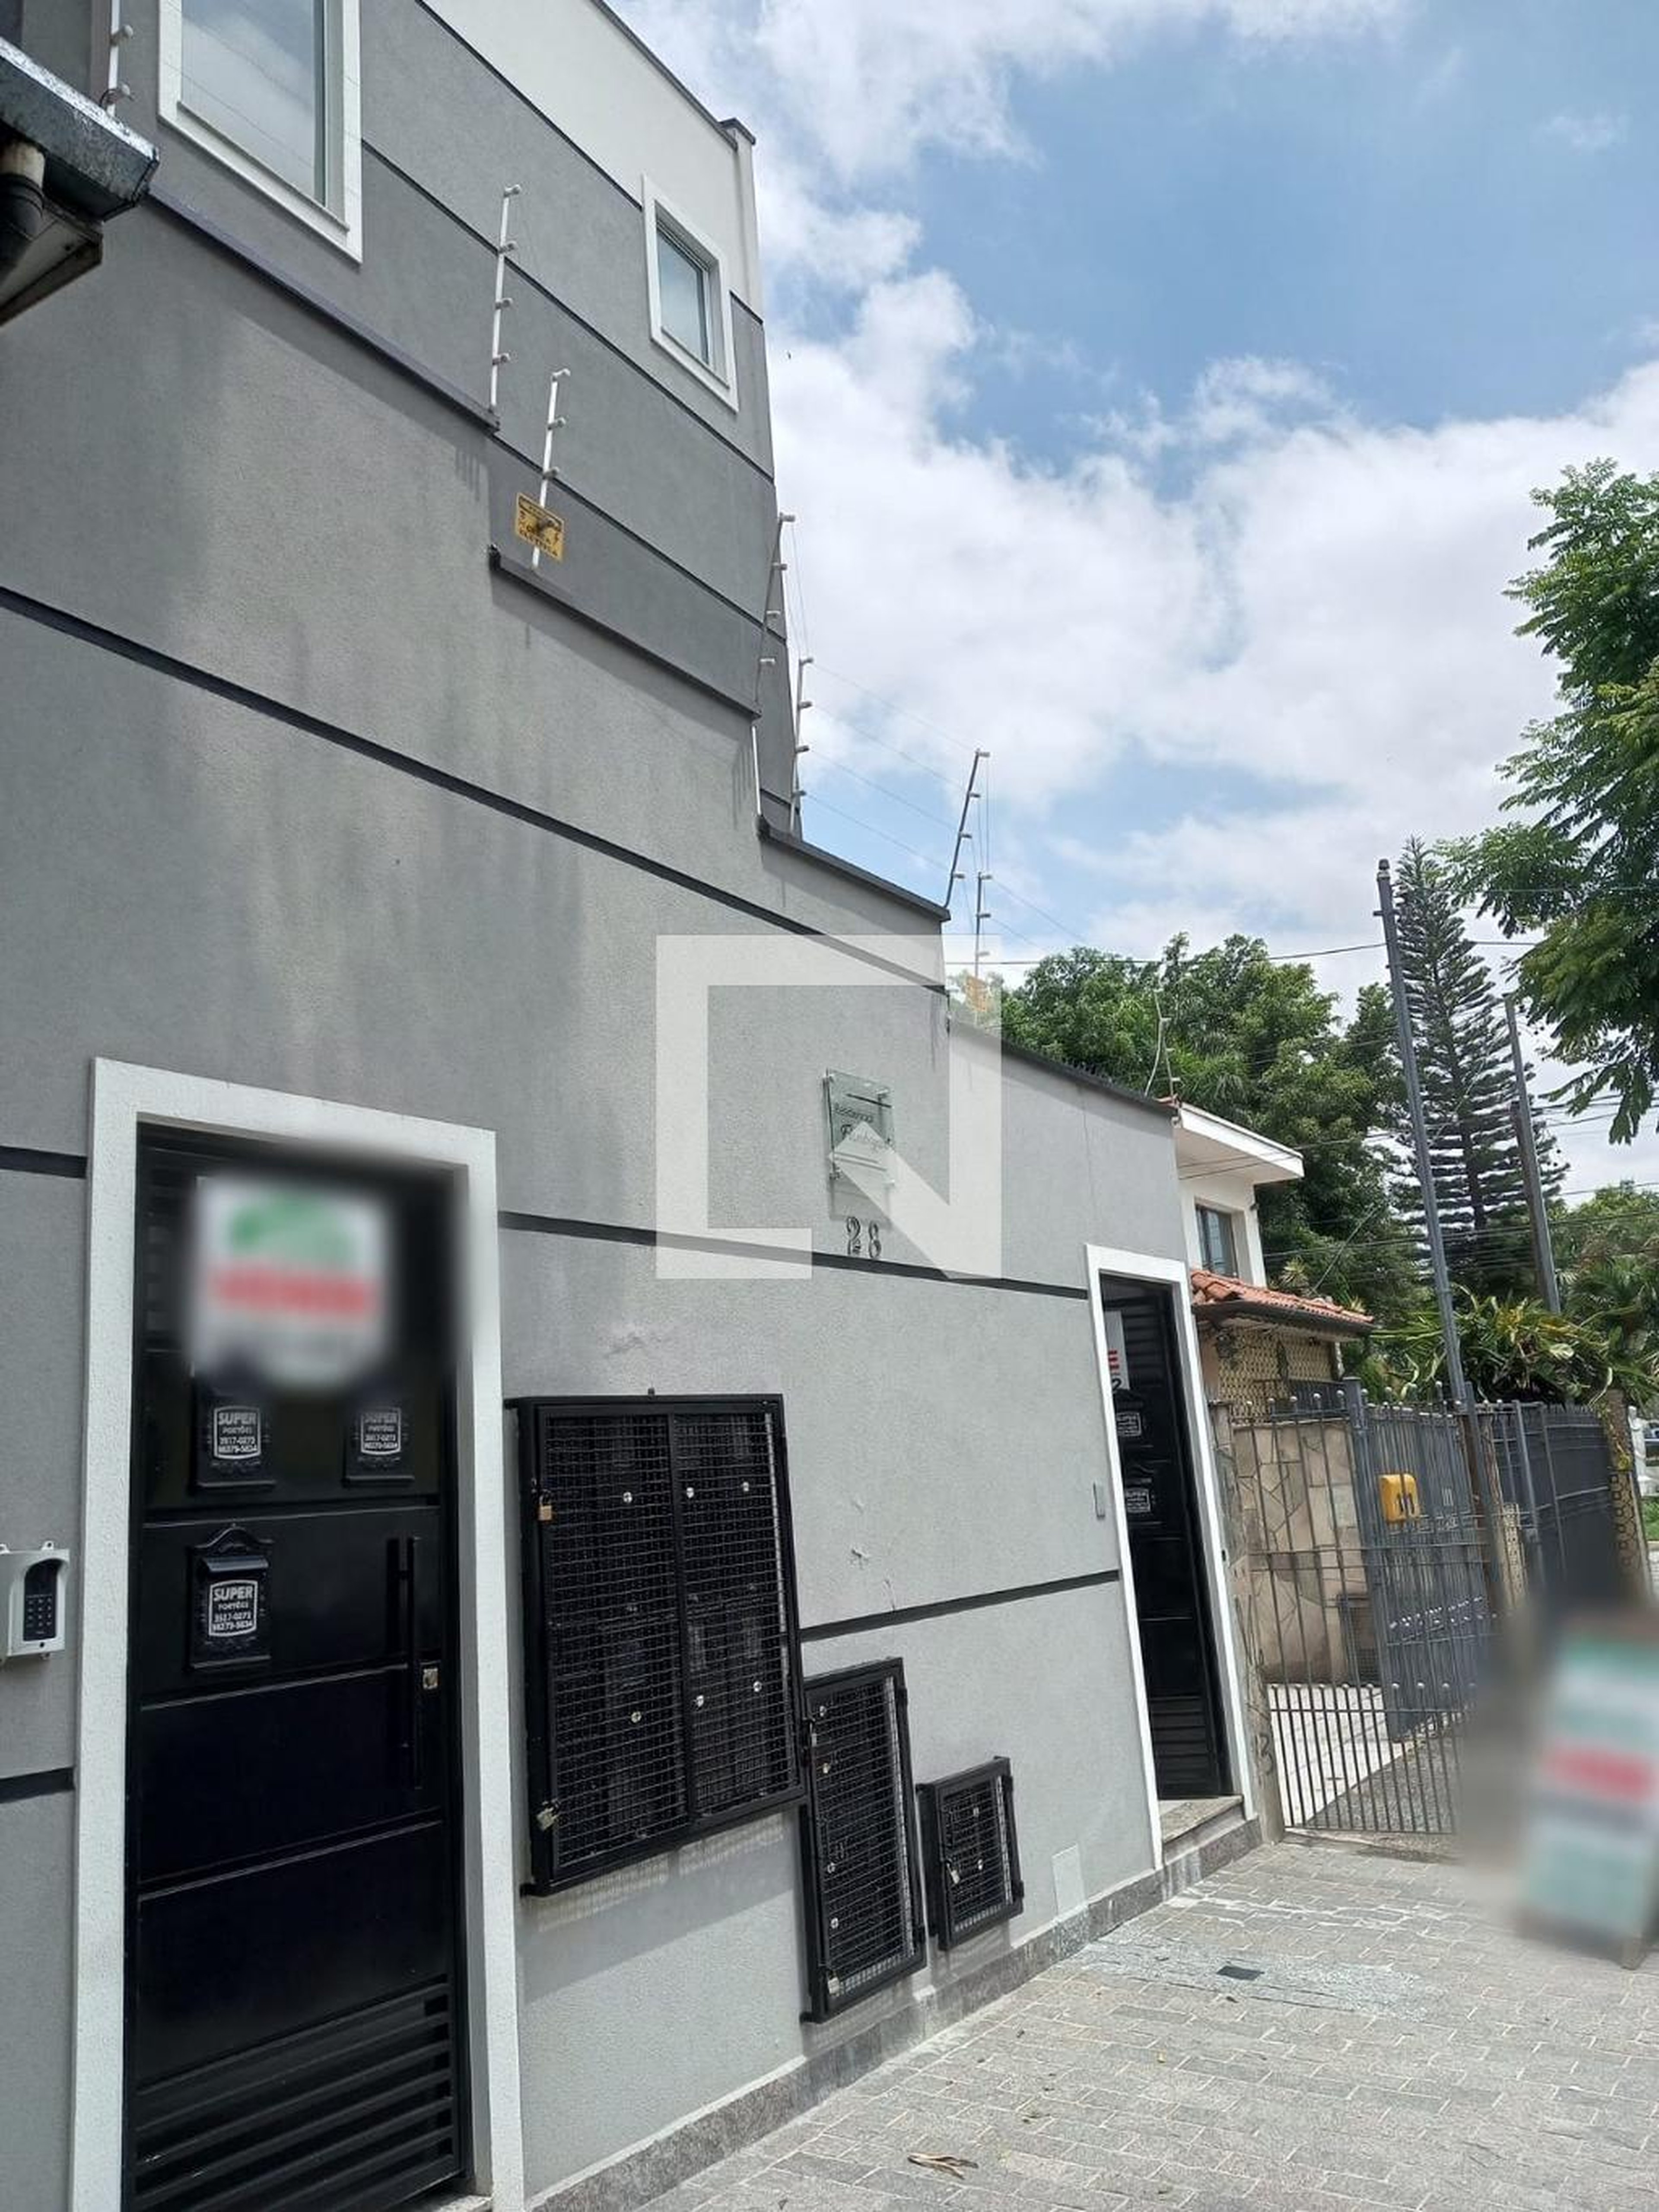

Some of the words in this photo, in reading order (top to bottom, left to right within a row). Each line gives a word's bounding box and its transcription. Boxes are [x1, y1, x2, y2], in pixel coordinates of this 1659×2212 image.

[846, 1216, 882, 1258] 28
[218, 1412, 256, 1426] SUPER
[364, 1412, 397, 1423] SUPER
[213, 1586, 253, 1601] SUPER
